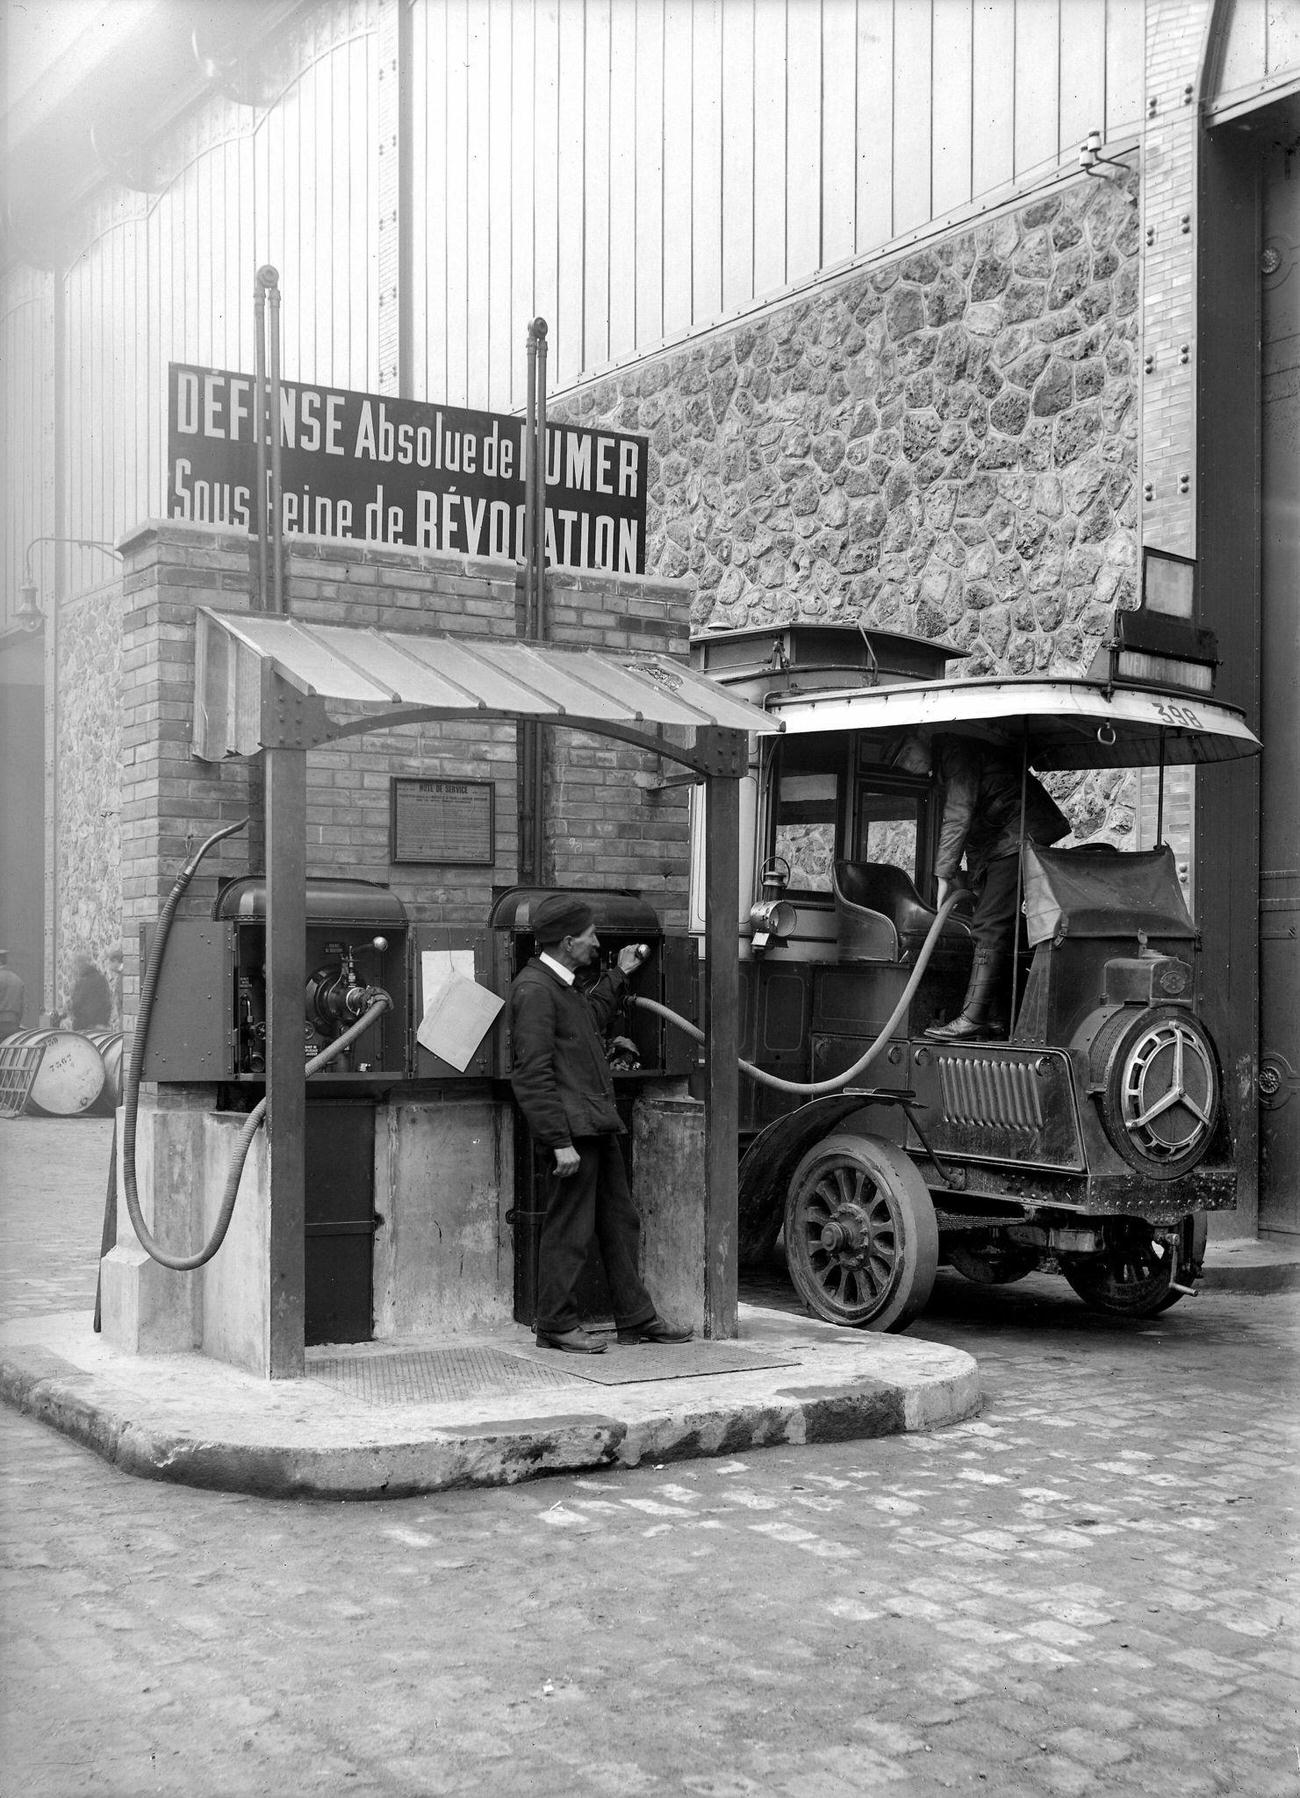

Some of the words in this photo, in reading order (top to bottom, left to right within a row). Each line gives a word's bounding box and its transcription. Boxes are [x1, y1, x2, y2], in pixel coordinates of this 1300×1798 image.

[355, 400, 477, 474] Absolue
[483, 420, 513, 480] de
[174, 458, 251, 527] Sous
[366, 485, 404, 545] de
[1152, 702, 1204, 729] 398
